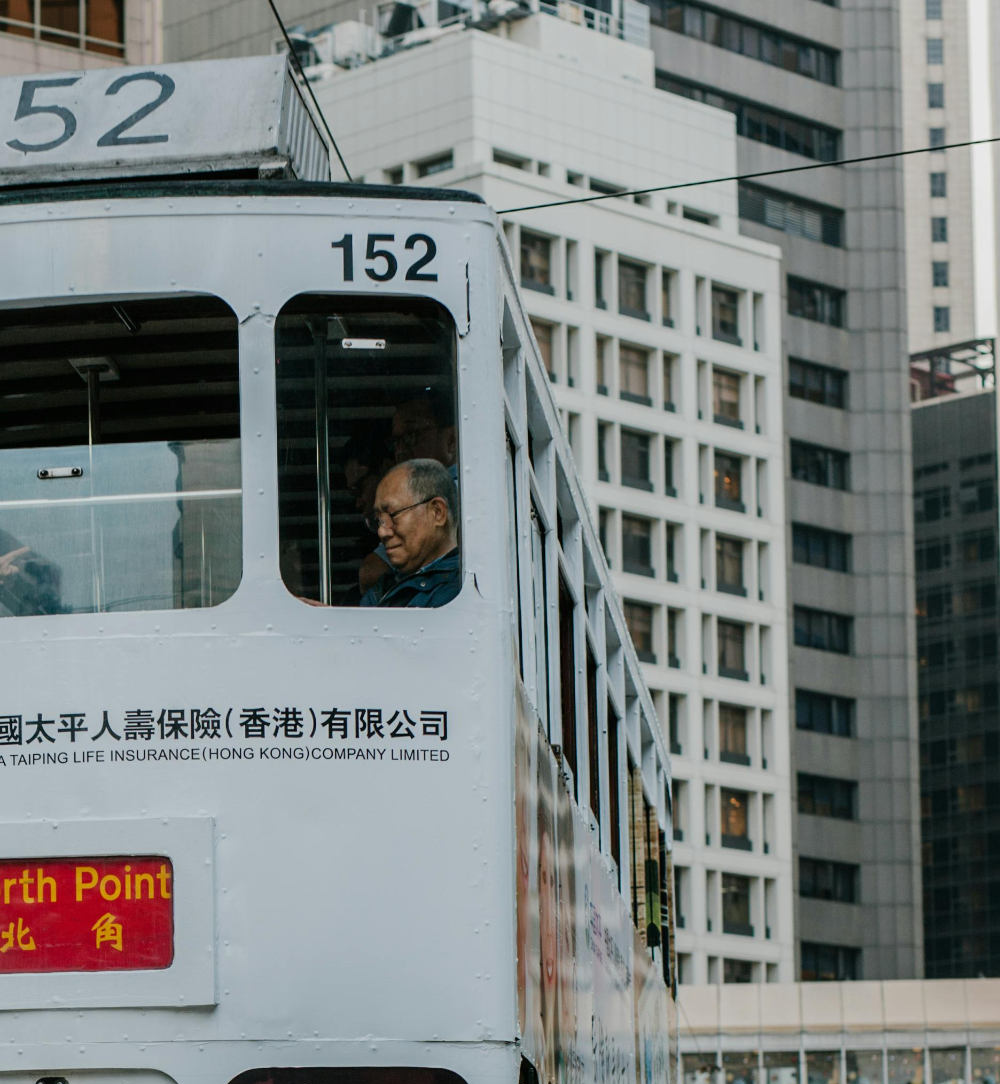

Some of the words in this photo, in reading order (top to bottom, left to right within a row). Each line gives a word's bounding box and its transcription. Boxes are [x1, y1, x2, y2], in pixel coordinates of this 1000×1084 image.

[331, 233, 438, 282] 152
[13, 752, 68, 766] TAIPING
[74, 750, 105, 763] LIFE
[391, 749, 450, 762] LIMITED
[76, 864, 172, 901] Point
[0, 912, 122, 952] 北角
